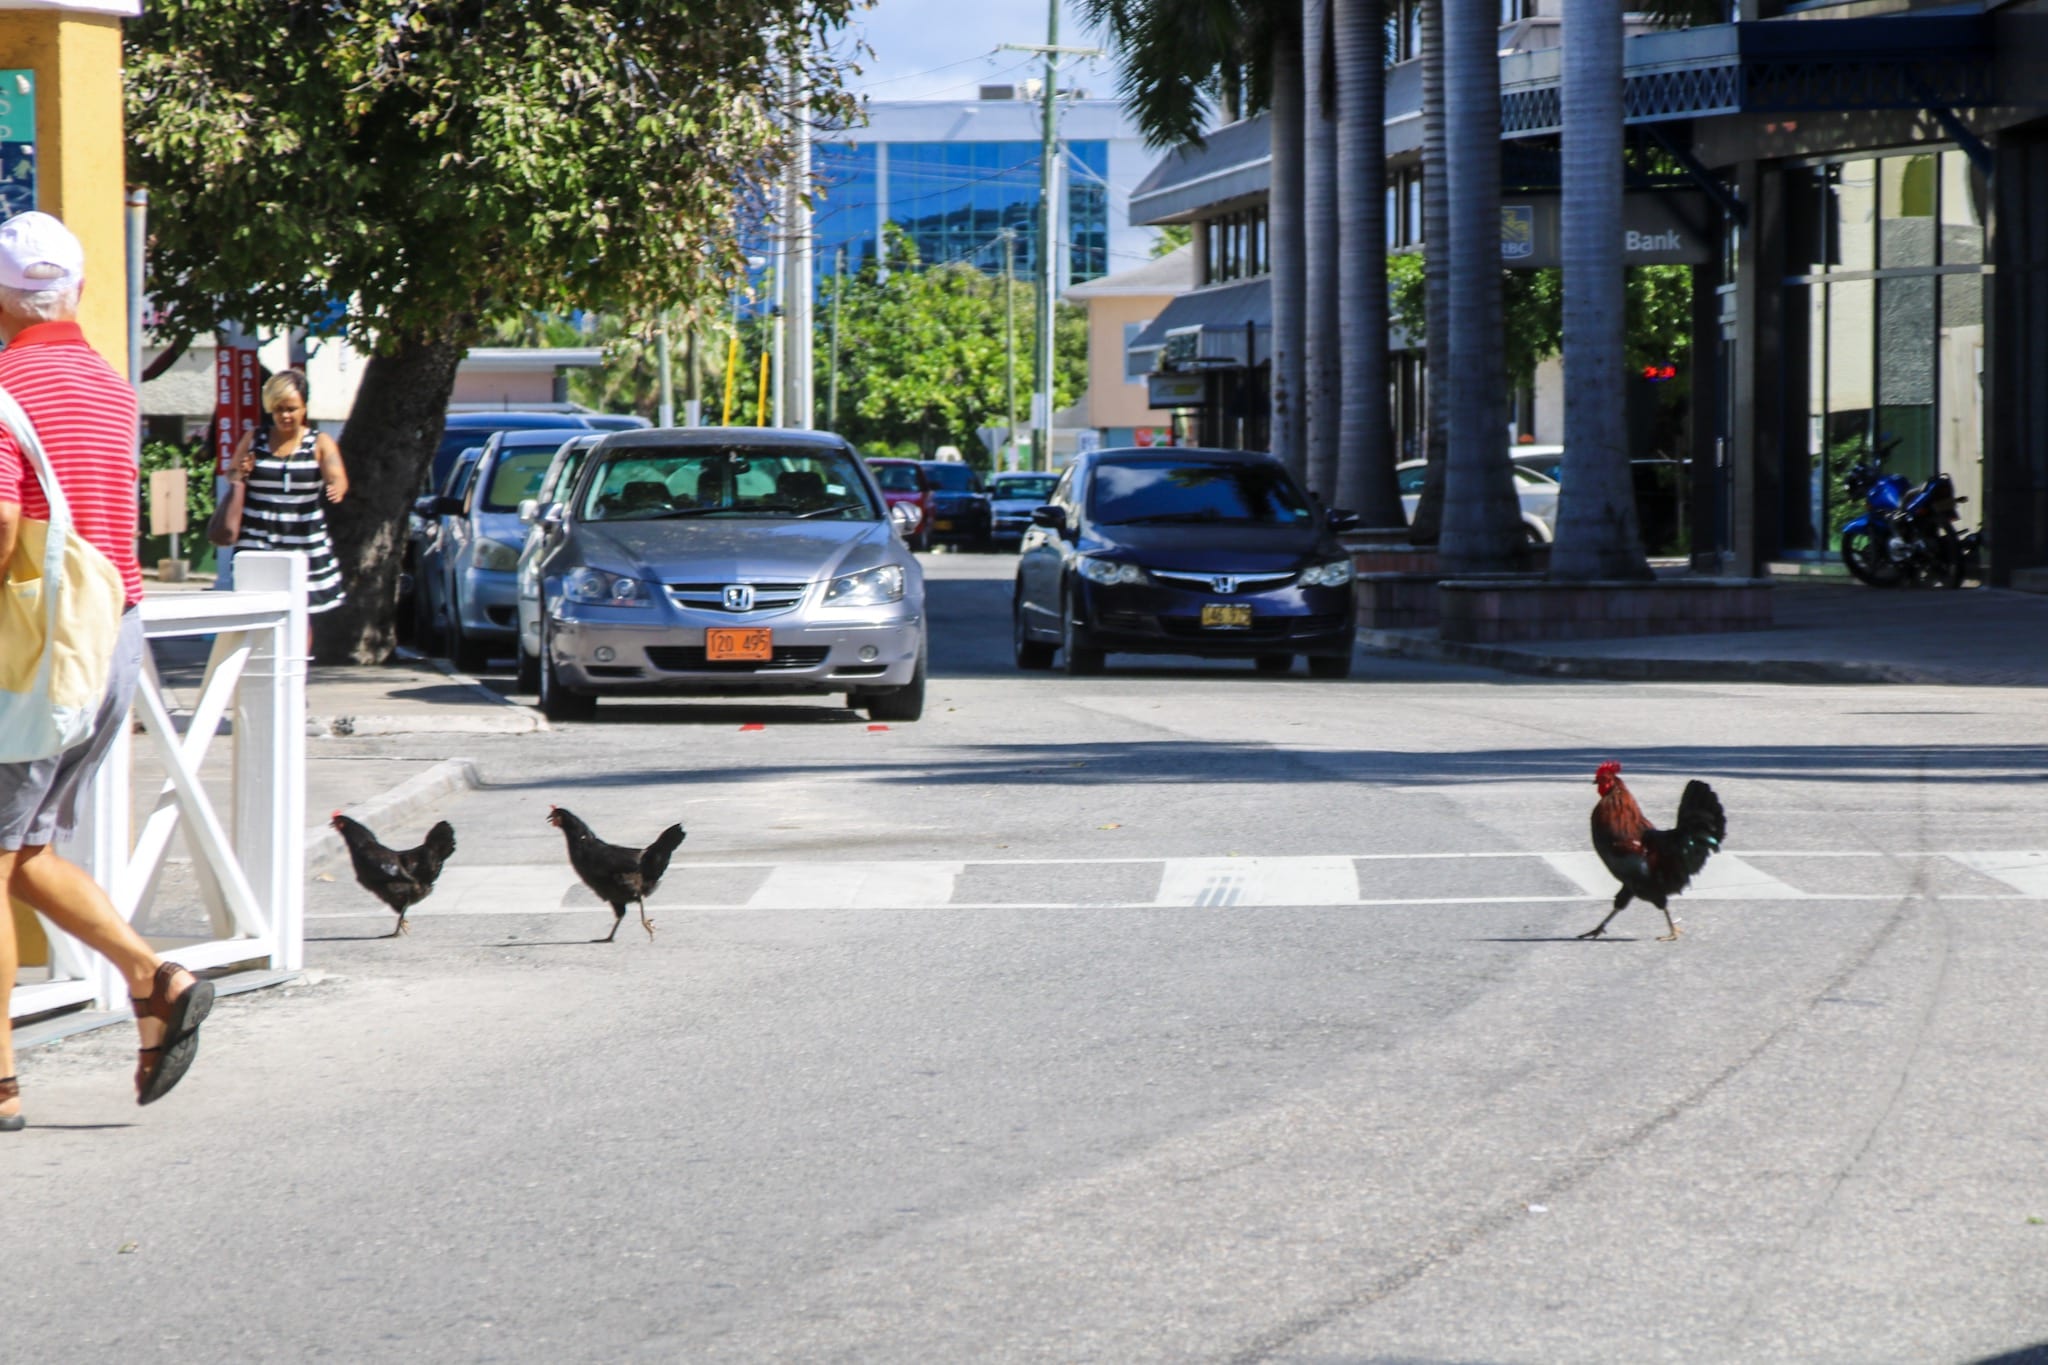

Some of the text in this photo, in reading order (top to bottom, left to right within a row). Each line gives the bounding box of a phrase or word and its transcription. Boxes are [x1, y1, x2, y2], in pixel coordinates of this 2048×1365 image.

[1625, 229, 1681, 251] Bank
[219, 349, 231, 405] SALE
[241, 353, 253, 406] SALE
[711, 631, 769, 652] 120 495
